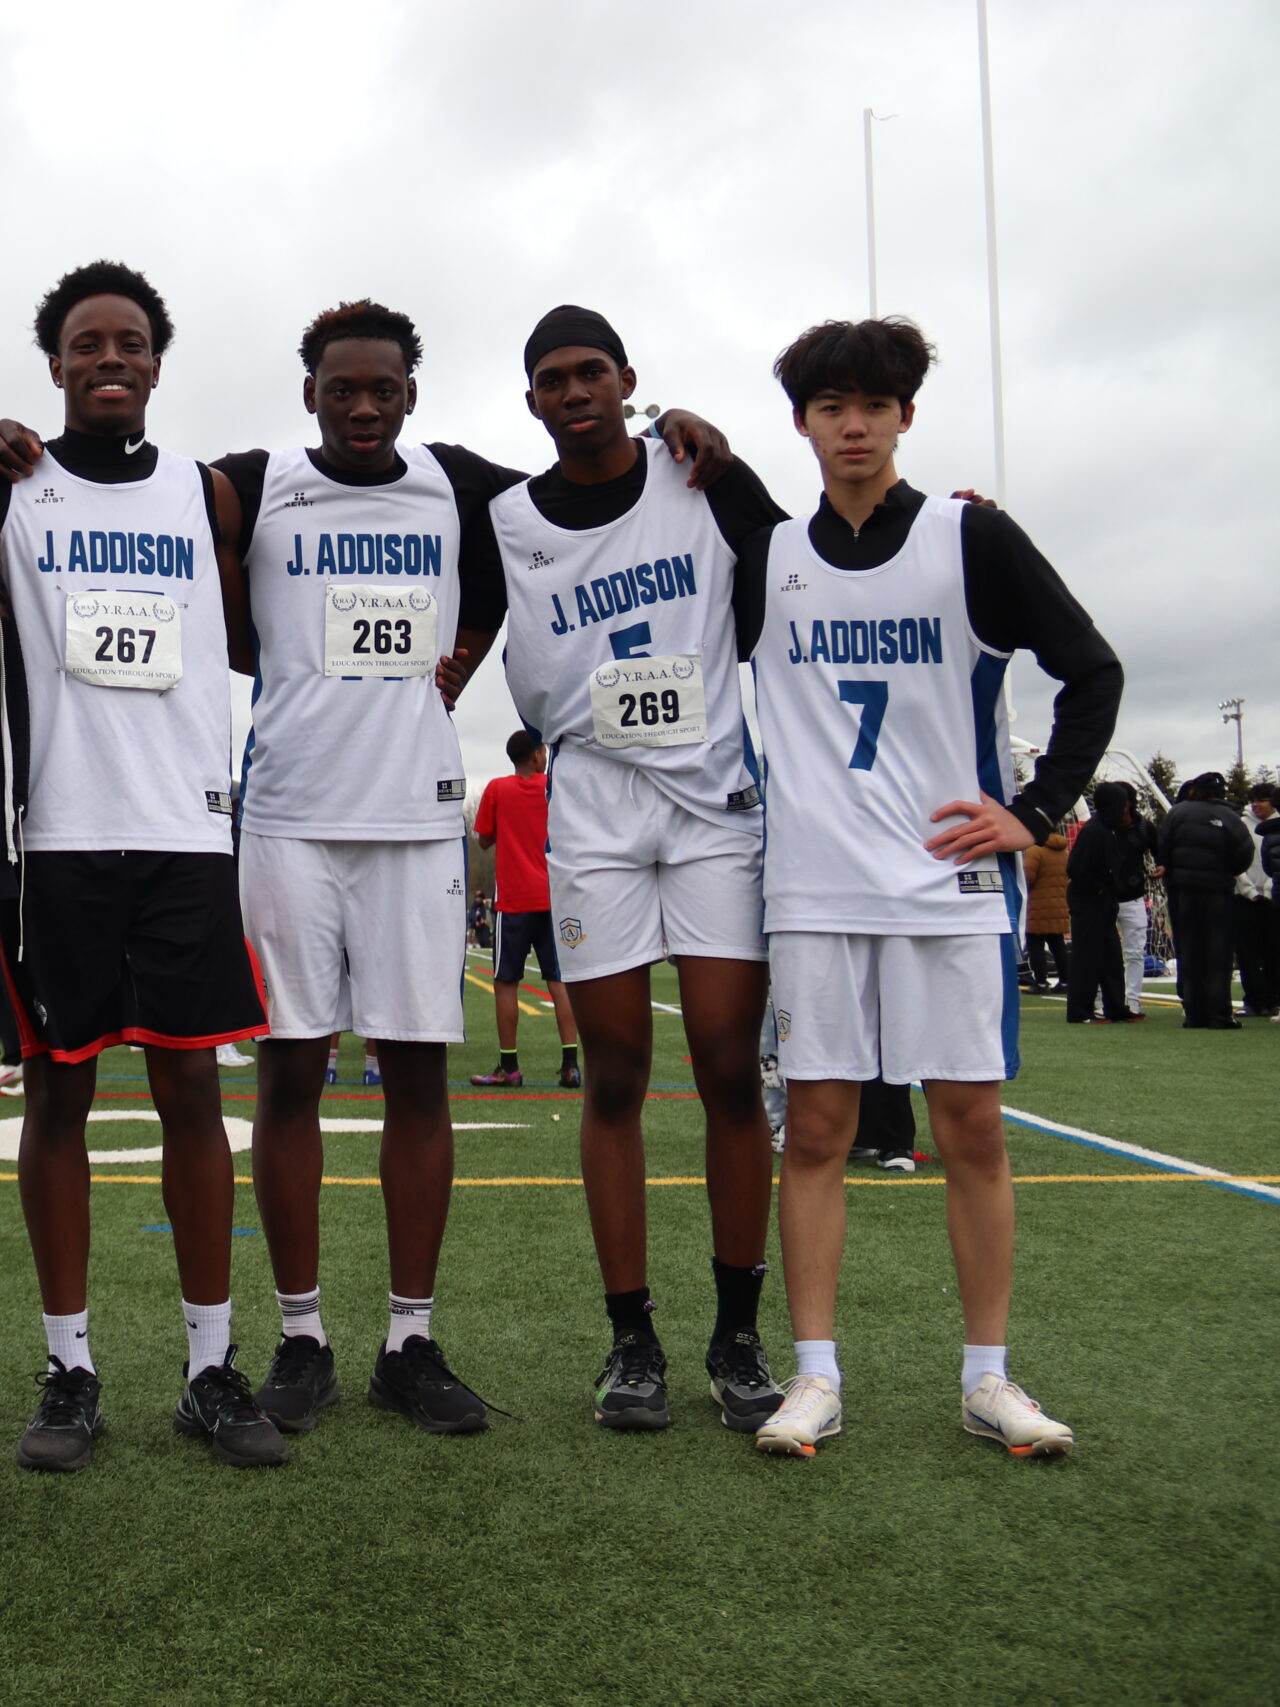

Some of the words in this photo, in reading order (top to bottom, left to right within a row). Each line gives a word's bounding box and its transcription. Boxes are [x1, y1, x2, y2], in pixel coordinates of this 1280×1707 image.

[38, 530, 61, 573] J.
[68, 530, 194, 580] ADDISON
[287, 534, 310, 576] J.
[317, 534, 442, 577] ADDISON
[102, 605, 151, 617] Y.R.A.A.
[360, 598, 407, 608] Y.R.A.A.
[551, 593, 576, 636] J.
[574, 553, 698, 627] ADDISON
[95, 626, 156, 664] 267
[352, 619, 412, 655] 263
[788, 620, 809, 664] J.
[810, 617, 943, 664] ADDISON
[72, 667, 116, 677] EDUCATION
[118, 669, 154, 678] THROUGH
[154, 671, 176, 679] SPORT
[623, 669, 671, 682] Y.R.A.A.
[618, 689, 680, 727] 269
[837, 680, 889, 771] 7
[601, 731, 642, 740] EDUCATION
[643, 729, 679, 738] THROUGH
